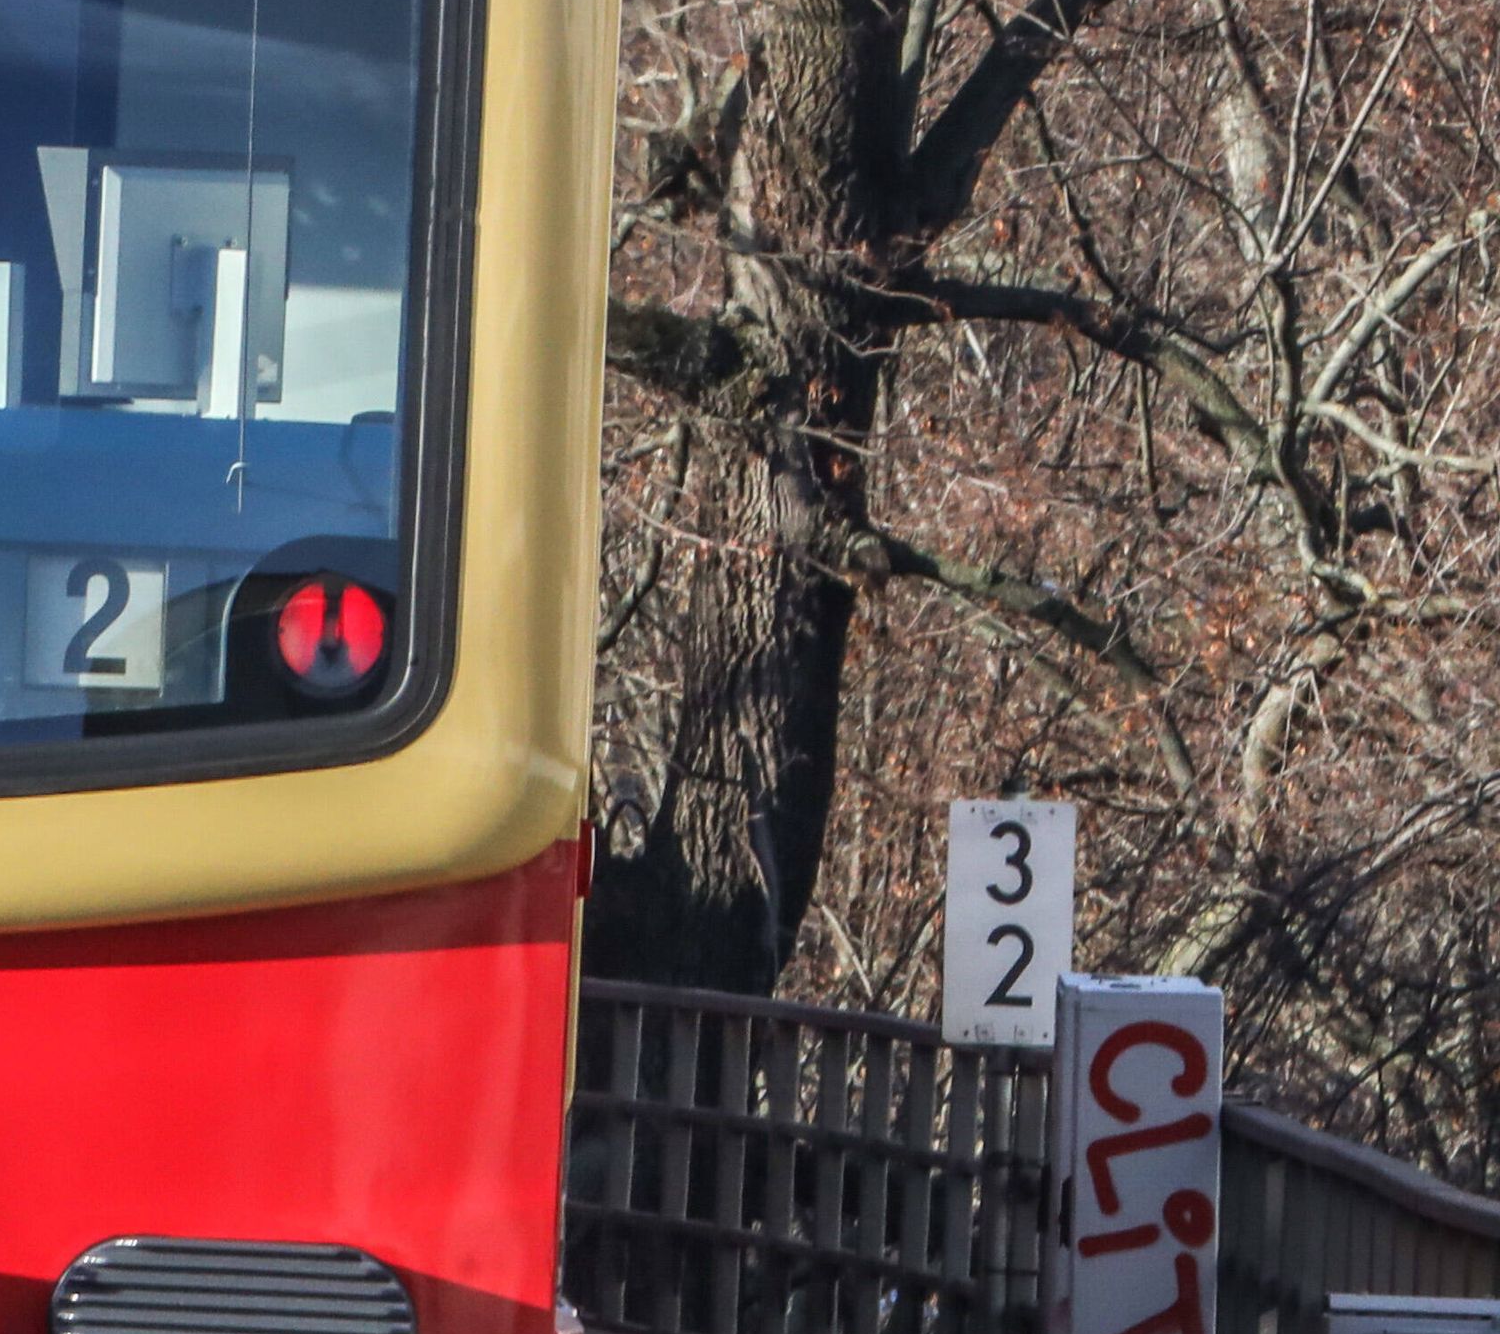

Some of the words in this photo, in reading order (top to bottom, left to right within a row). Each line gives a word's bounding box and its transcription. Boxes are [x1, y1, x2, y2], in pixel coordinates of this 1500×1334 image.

[63, 556, 130, 674] 2
[986, 820, 1033, 905] 3
[985, 923, 1034, 1007] 2
